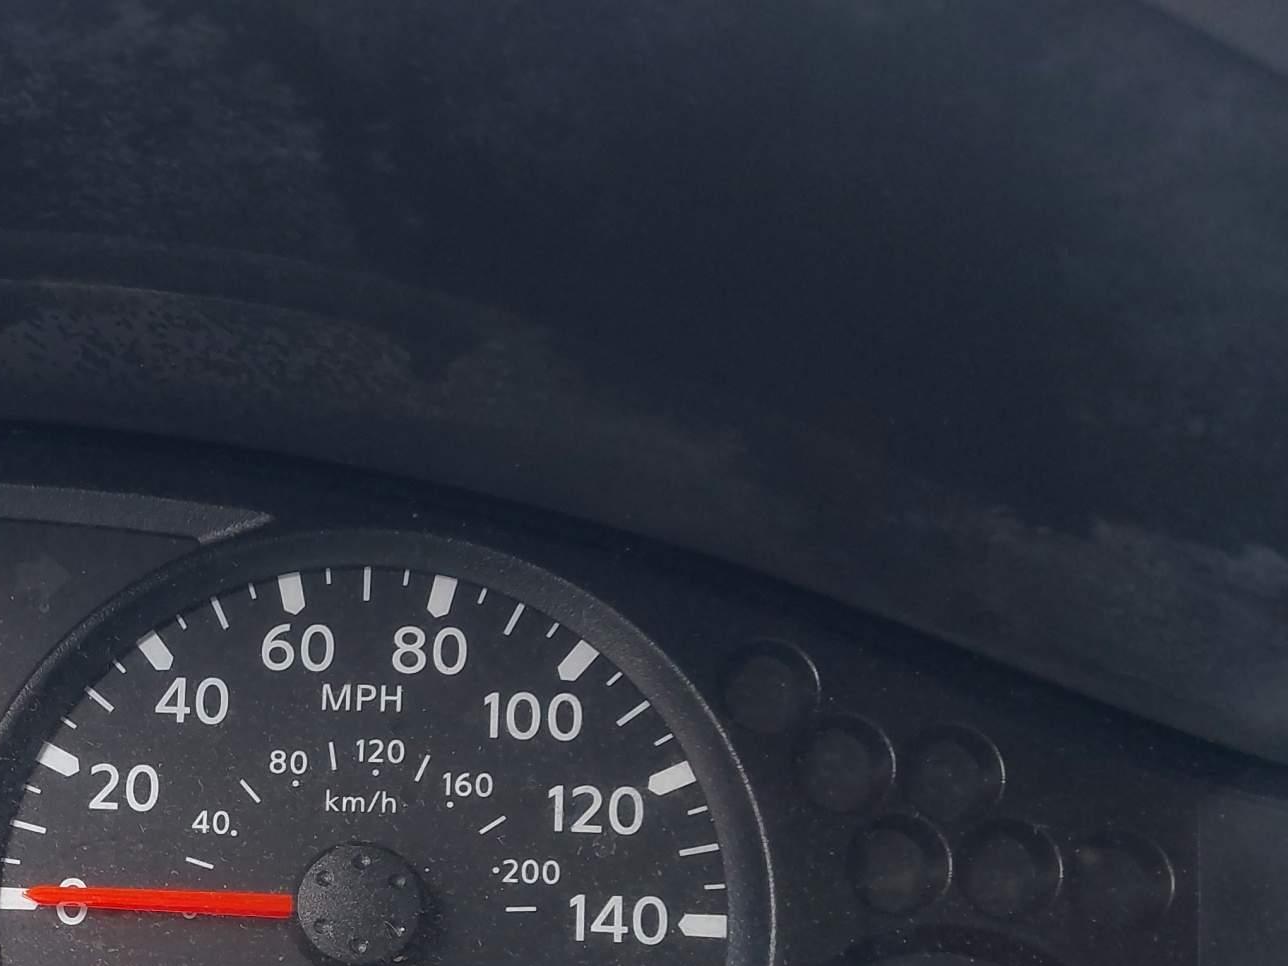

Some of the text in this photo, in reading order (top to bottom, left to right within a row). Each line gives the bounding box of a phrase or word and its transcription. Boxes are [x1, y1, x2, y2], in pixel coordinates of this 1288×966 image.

[262, 624, 334, 671] 60
[392, 627, 466, 674] 80
[155, 678, 228, 724] 40
[322, 684, 402, 712] MPH
[485, 692, 582, 741] 100
[270, 750, 307, 774] 80
[357, 740, 404, 763] 120
[89, 764, 158, 811] 20
[326, 790, 396, 812] km/h
[443, 773, 492, 797] 160
[549, 786, 643, 834] 120
[501, 860, 560, 884] 200
[570, 895, 667, 944] 140
